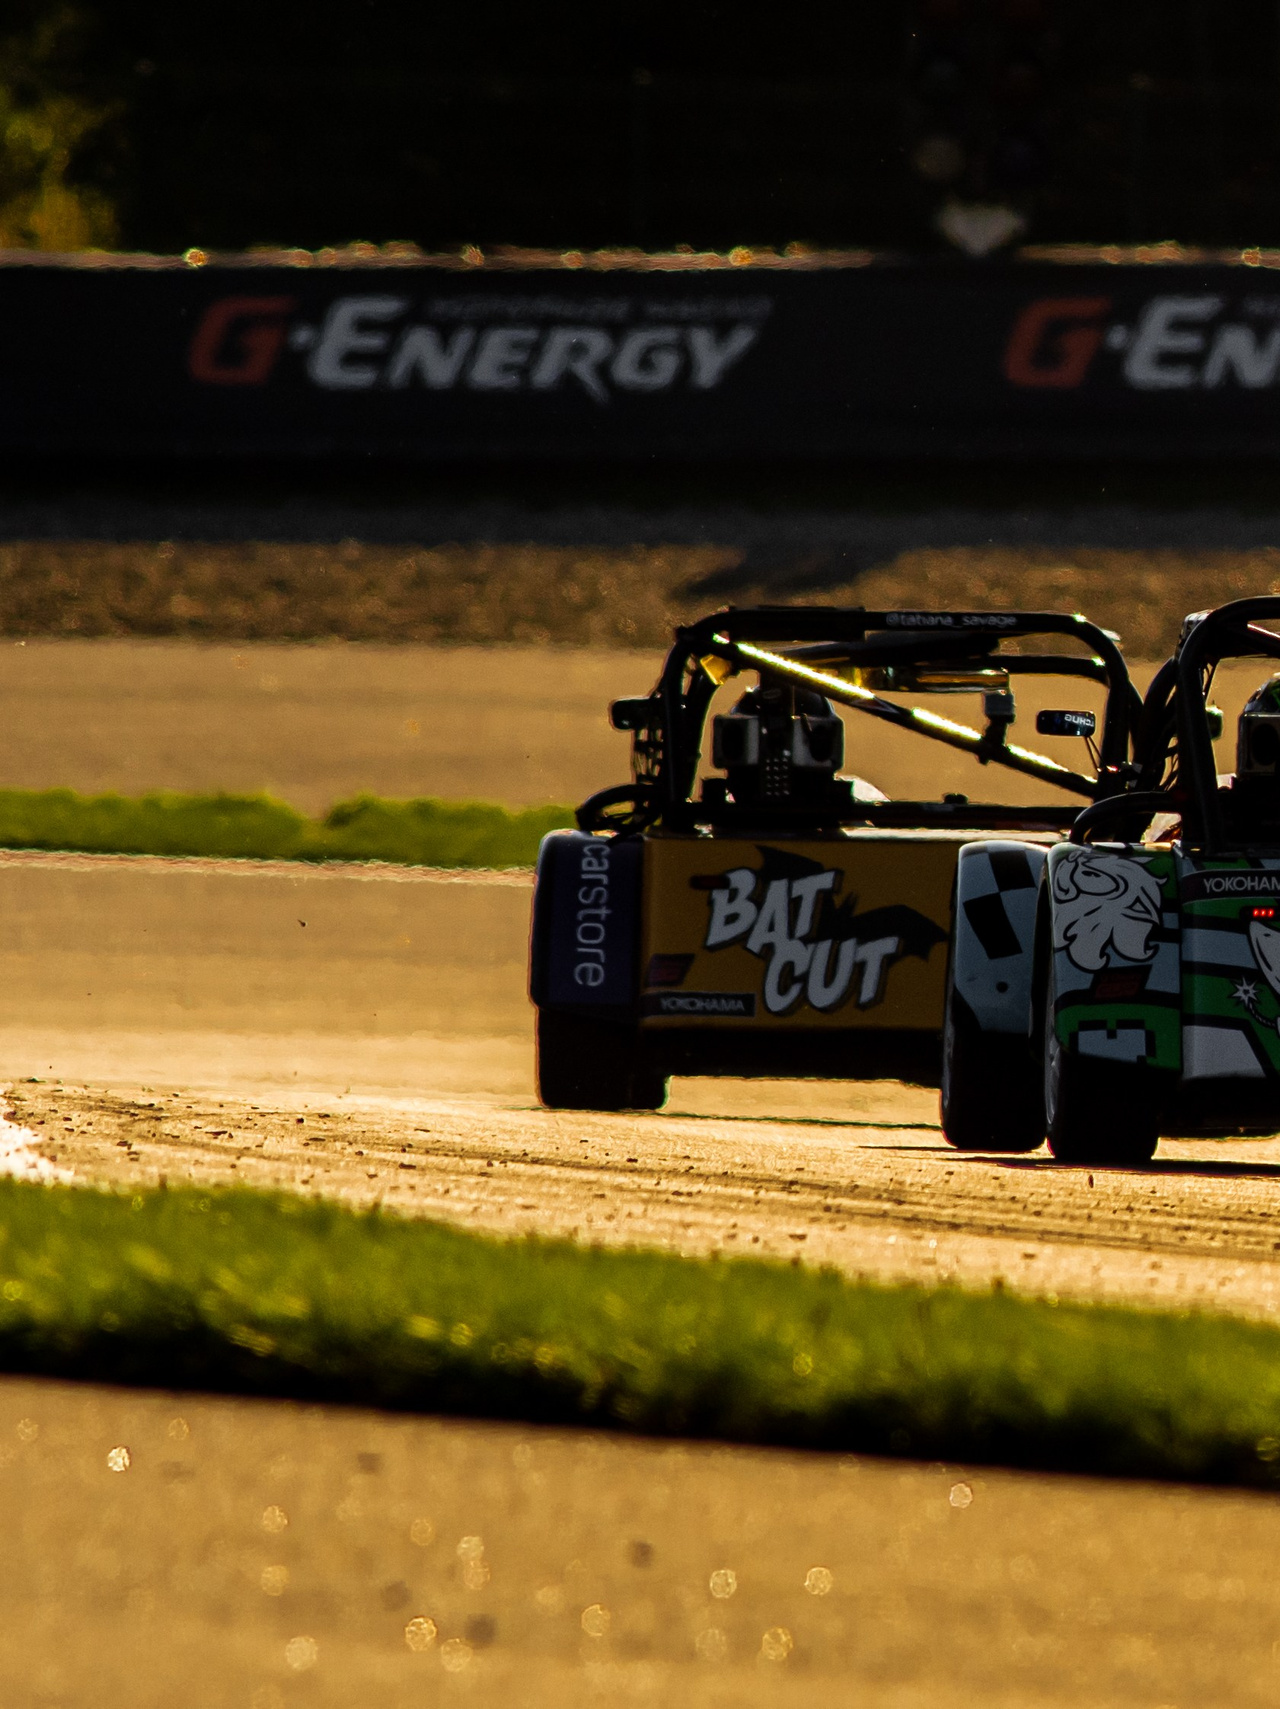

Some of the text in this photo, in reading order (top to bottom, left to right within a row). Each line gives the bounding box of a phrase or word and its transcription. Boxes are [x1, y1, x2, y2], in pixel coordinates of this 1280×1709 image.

[573, 844, 612, 987] carstore
[704, 868, 838, 958] BAT
[660, 998, 745, 1013] YOKOHAMA
[763, 935, 901, 1014] CUT
